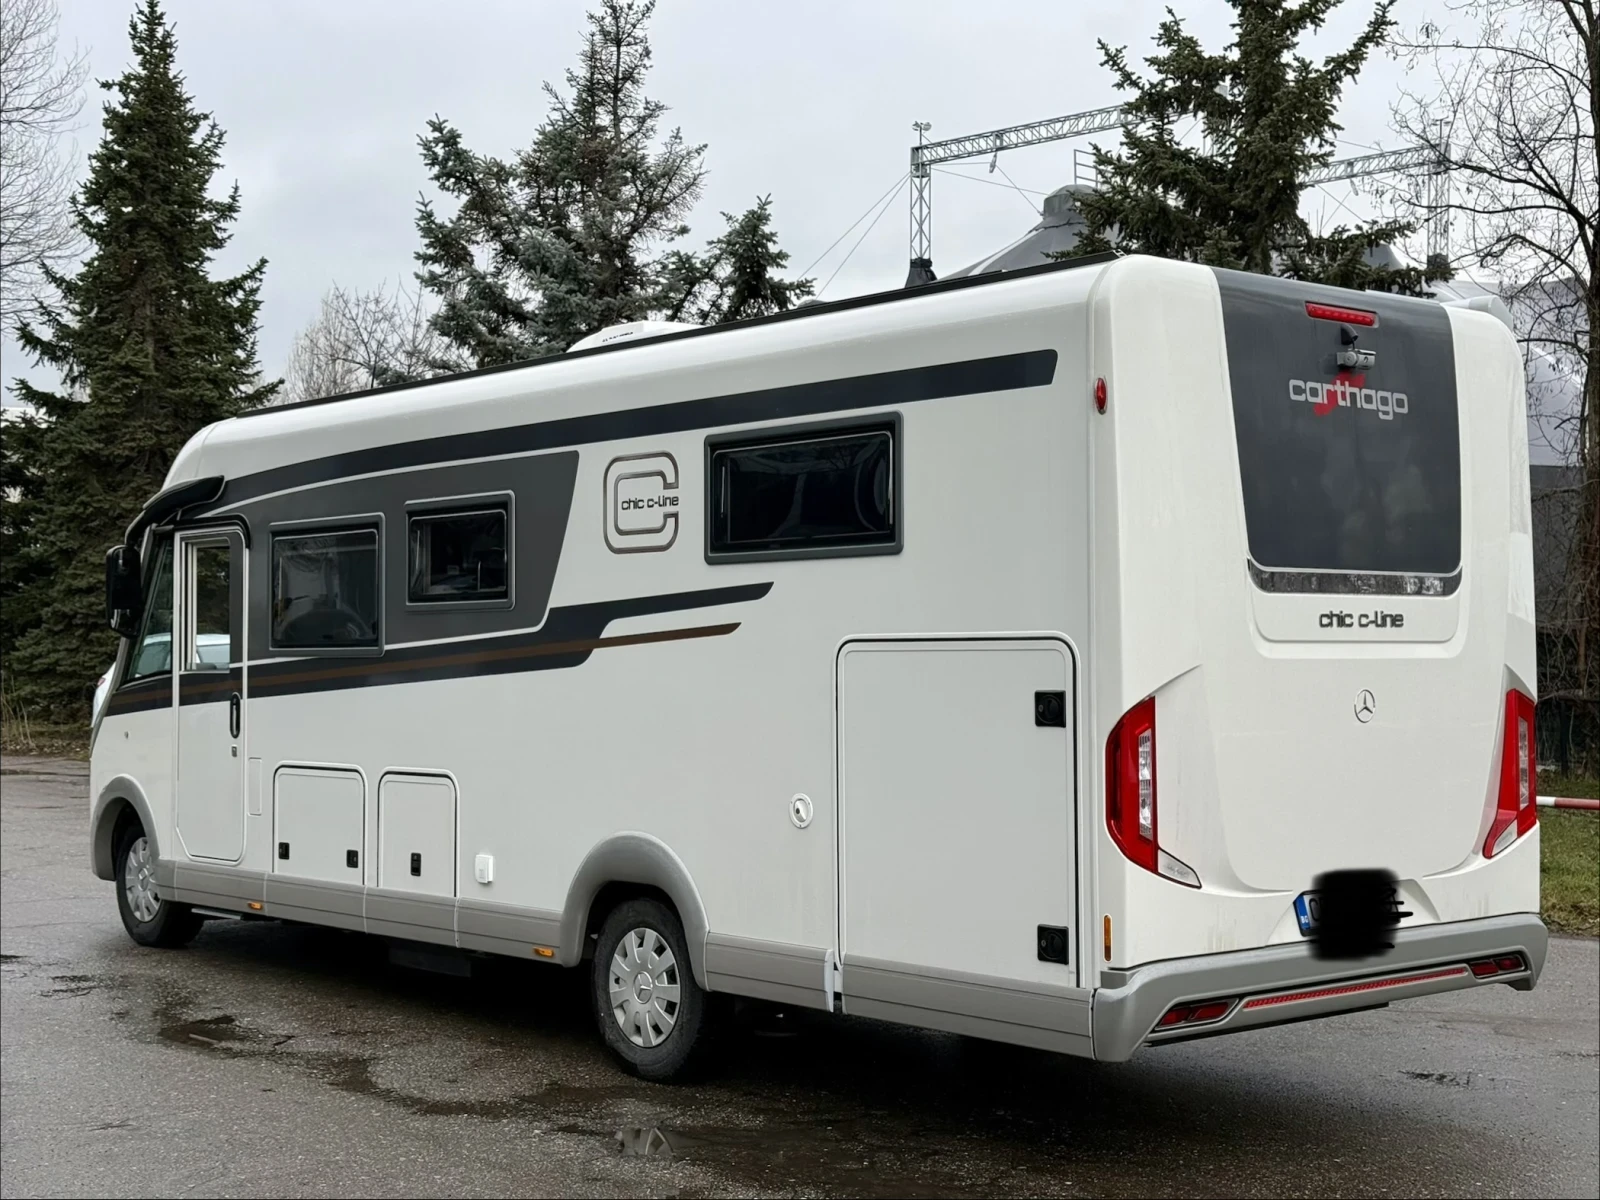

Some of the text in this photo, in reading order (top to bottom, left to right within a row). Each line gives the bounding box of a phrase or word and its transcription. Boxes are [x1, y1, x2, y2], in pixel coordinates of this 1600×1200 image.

[1289, 379, 1408, 420] carthago
[621, 495, 679, 510] chic c-line
[1319, 610, 1404, 628] chic c-line
